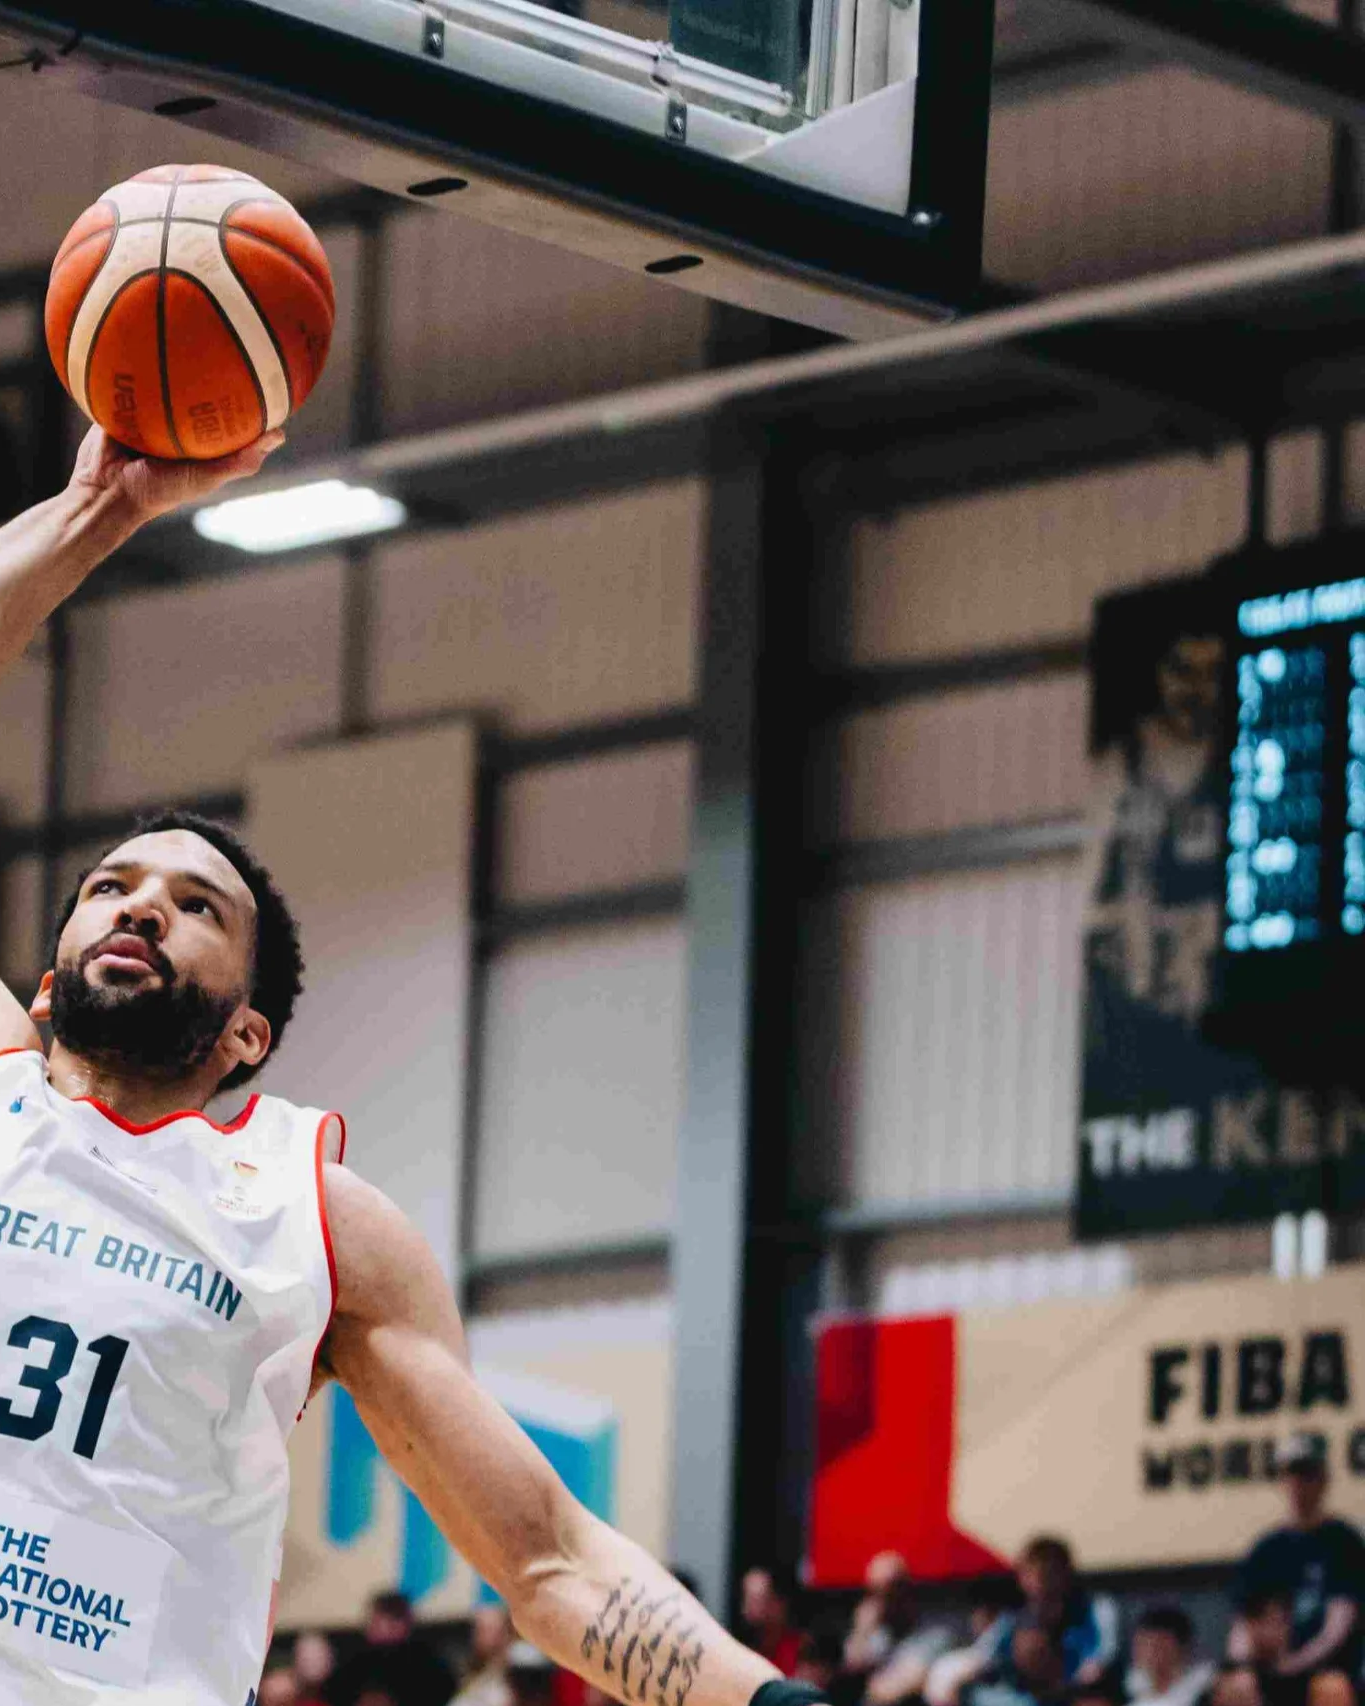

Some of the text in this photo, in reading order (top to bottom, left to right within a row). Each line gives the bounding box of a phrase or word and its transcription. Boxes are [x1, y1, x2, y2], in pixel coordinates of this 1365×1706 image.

[1086, 1108, 1196, 1177] THE
[94, 1235, 242, 1321] BRITAIN
[1150, 1331, 1349, 1423] FIBA
[1143, 1436, 1320, 1490] WORL
